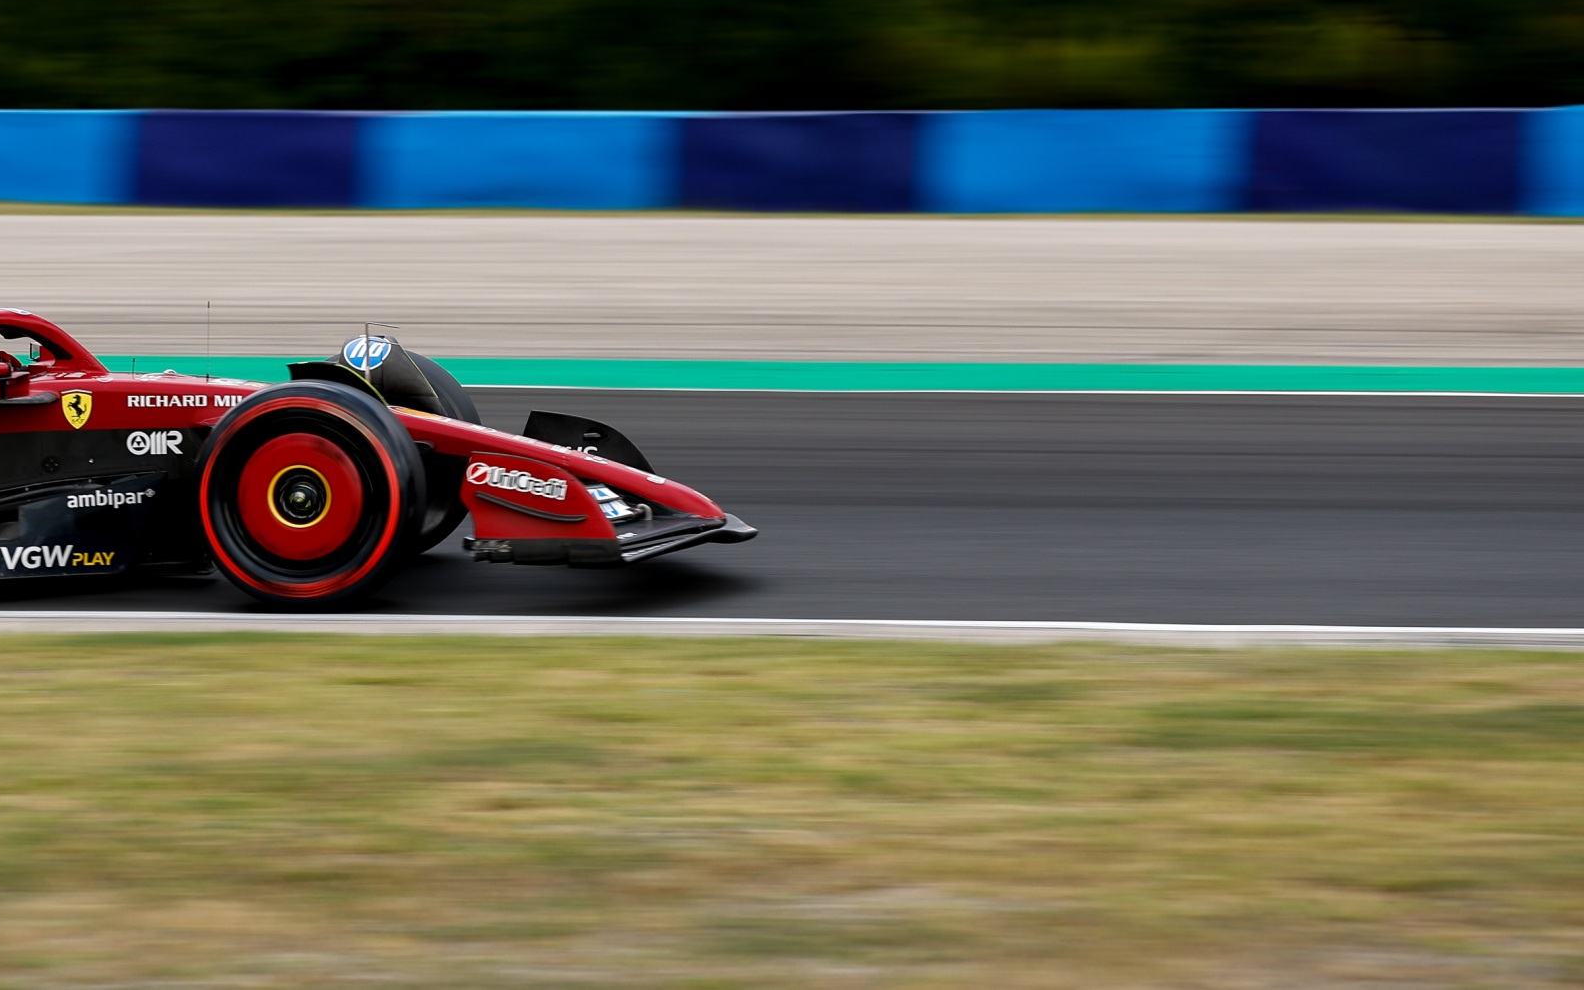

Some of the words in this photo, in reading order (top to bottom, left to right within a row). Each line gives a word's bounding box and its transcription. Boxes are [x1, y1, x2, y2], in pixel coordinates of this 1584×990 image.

[127, 395, 208, 408] RICHARD
[488, 467, 568, 501] UniCredit
[67, 490, 144, 509] ambipar
[0, 545, 74, 570] VGW
[72, 552, 115, 567] PLAY
